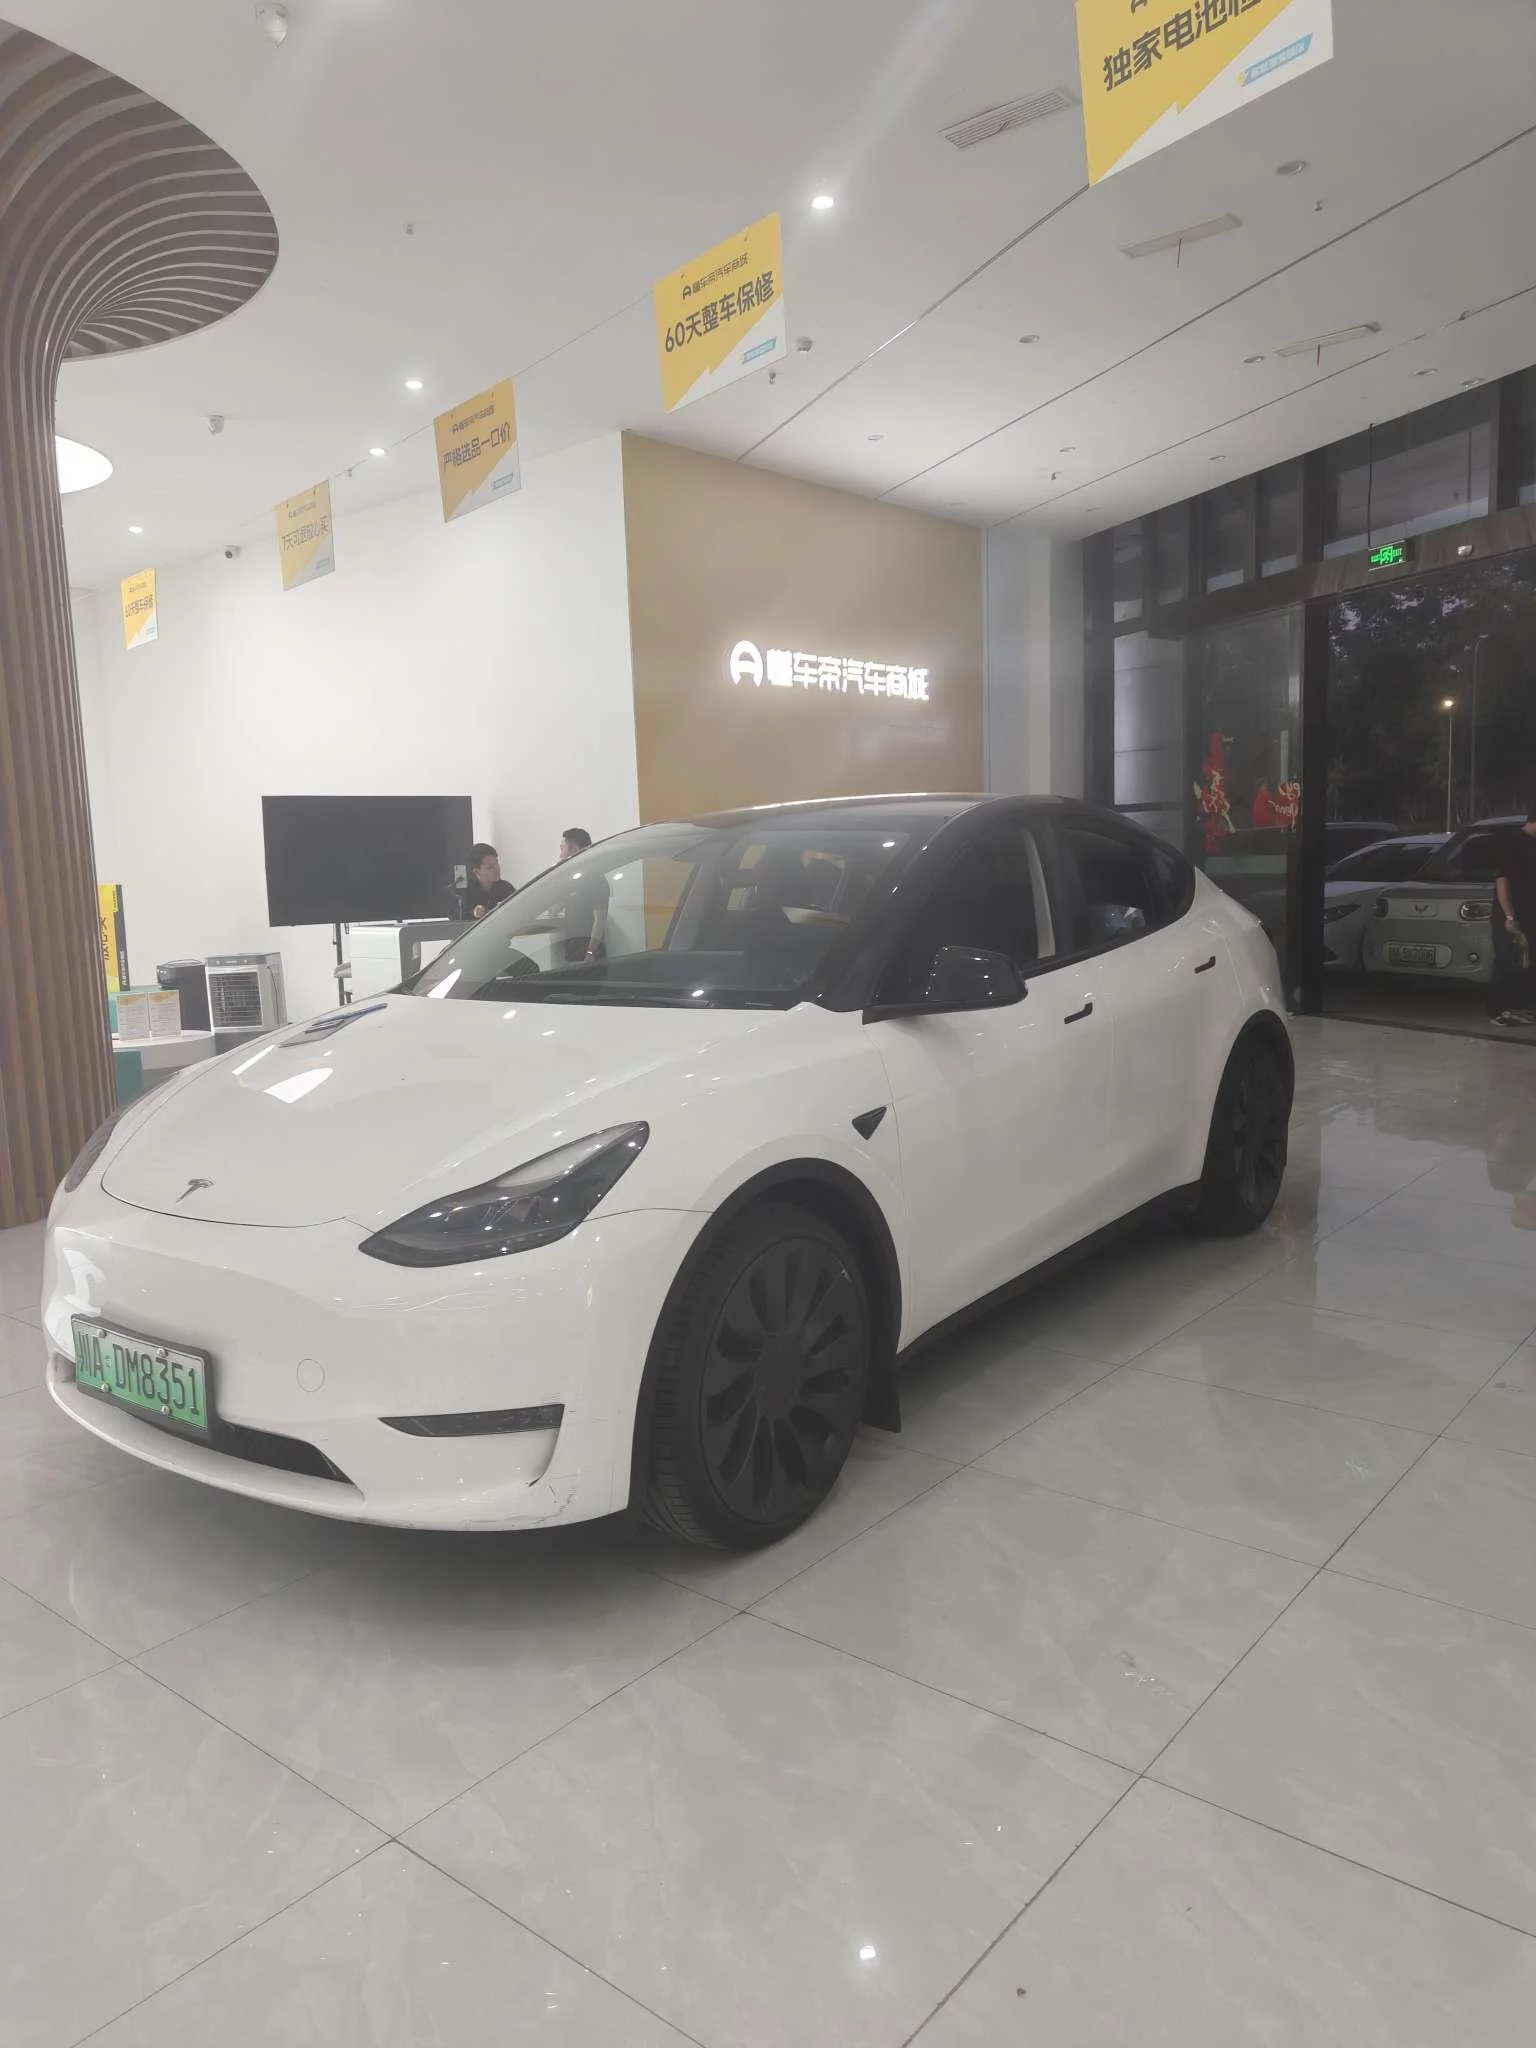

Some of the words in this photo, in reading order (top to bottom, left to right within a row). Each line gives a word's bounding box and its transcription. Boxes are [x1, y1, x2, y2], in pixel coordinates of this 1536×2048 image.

[665, 270, 774, 353] 60天整车保修
[766, 648, 930, 701] 车帝汽车商城
